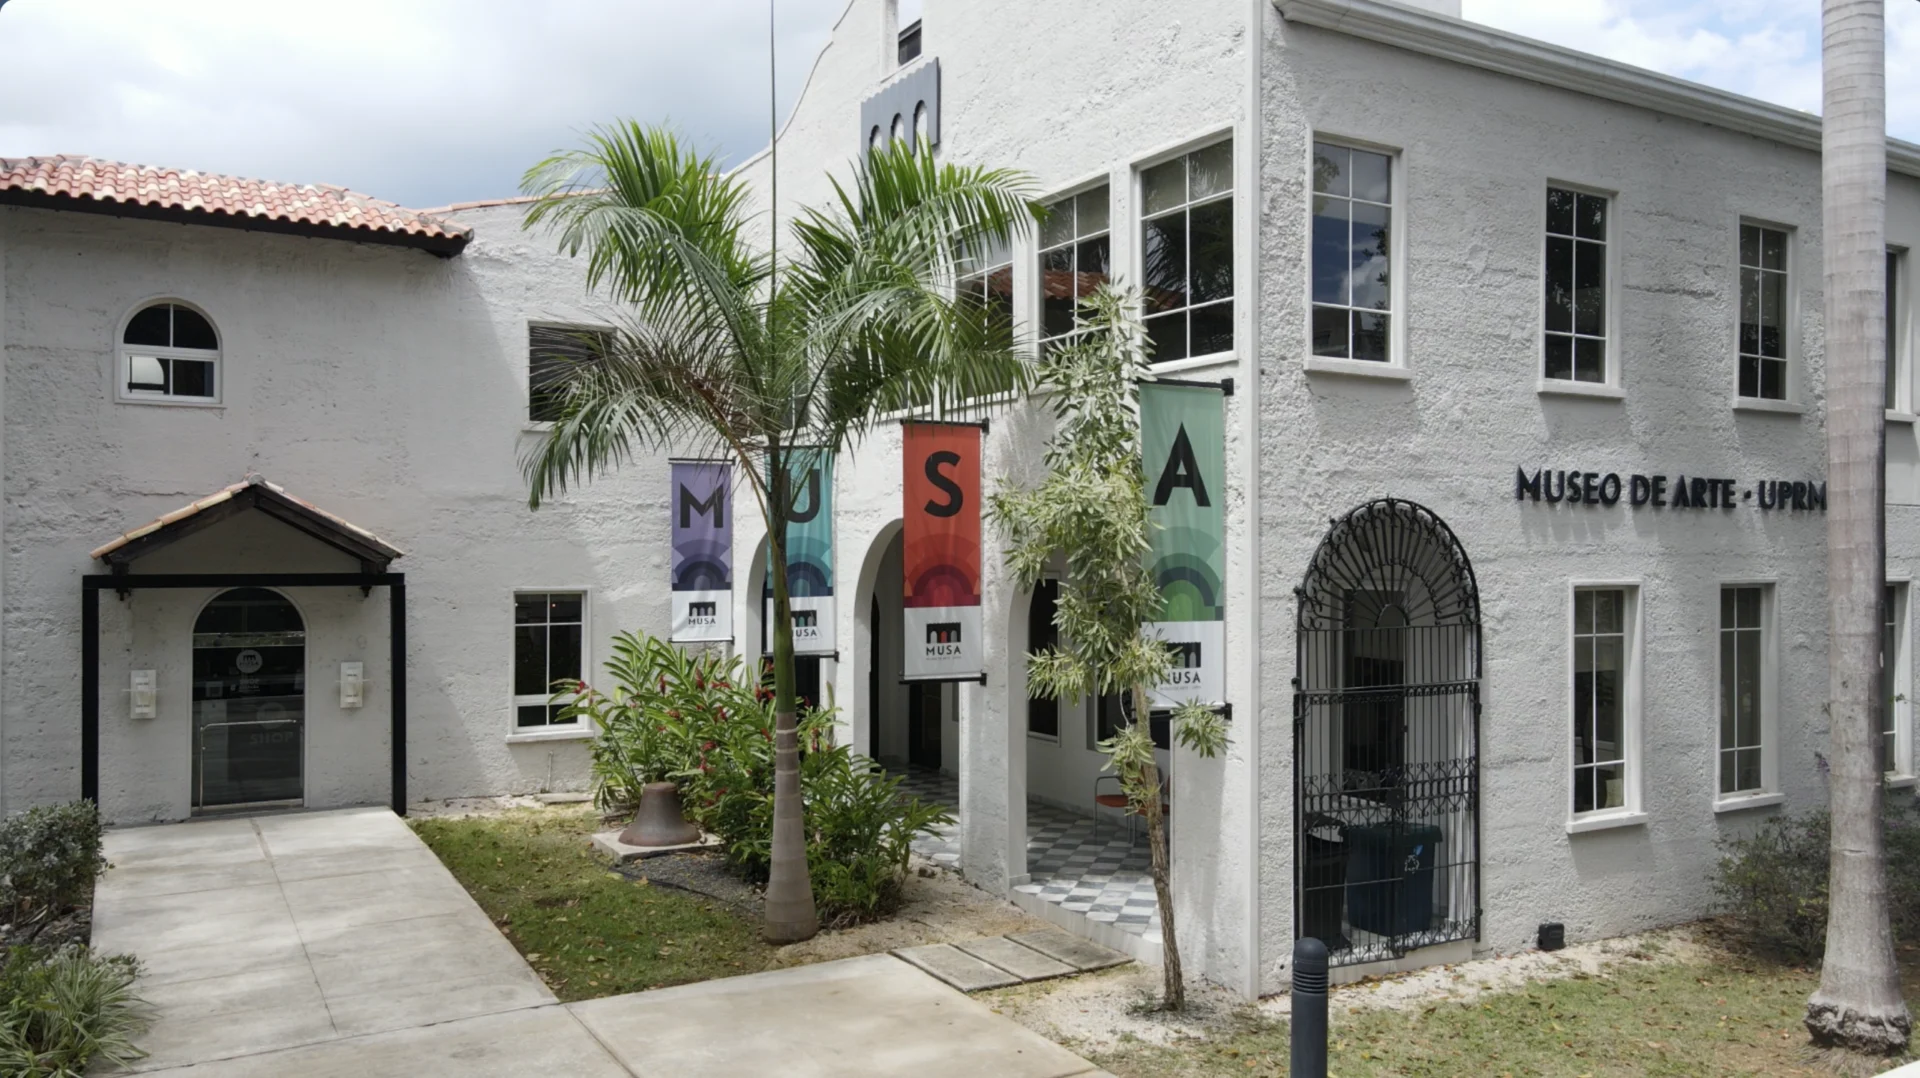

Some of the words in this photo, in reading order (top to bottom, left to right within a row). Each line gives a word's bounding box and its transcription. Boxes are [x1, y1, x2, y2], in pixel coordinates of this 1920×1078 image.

[924, 451, 963, 518] S
[1153, 422, 1211, 507] A
[1517, 464, 1621, 506] MUSEO
[1631, 474, 1666, 506] DE
[1672, 474, 1736, 509] ARTE
[1758, 480, 1827, 511] UPRM
[680, 483, 723, 529] M
[782, 468, 821, 524] U
[688, 617, 716, 625] MUSA
[792, 628, 817, 637] USA
[926, 645, 961, 656] MUSA
